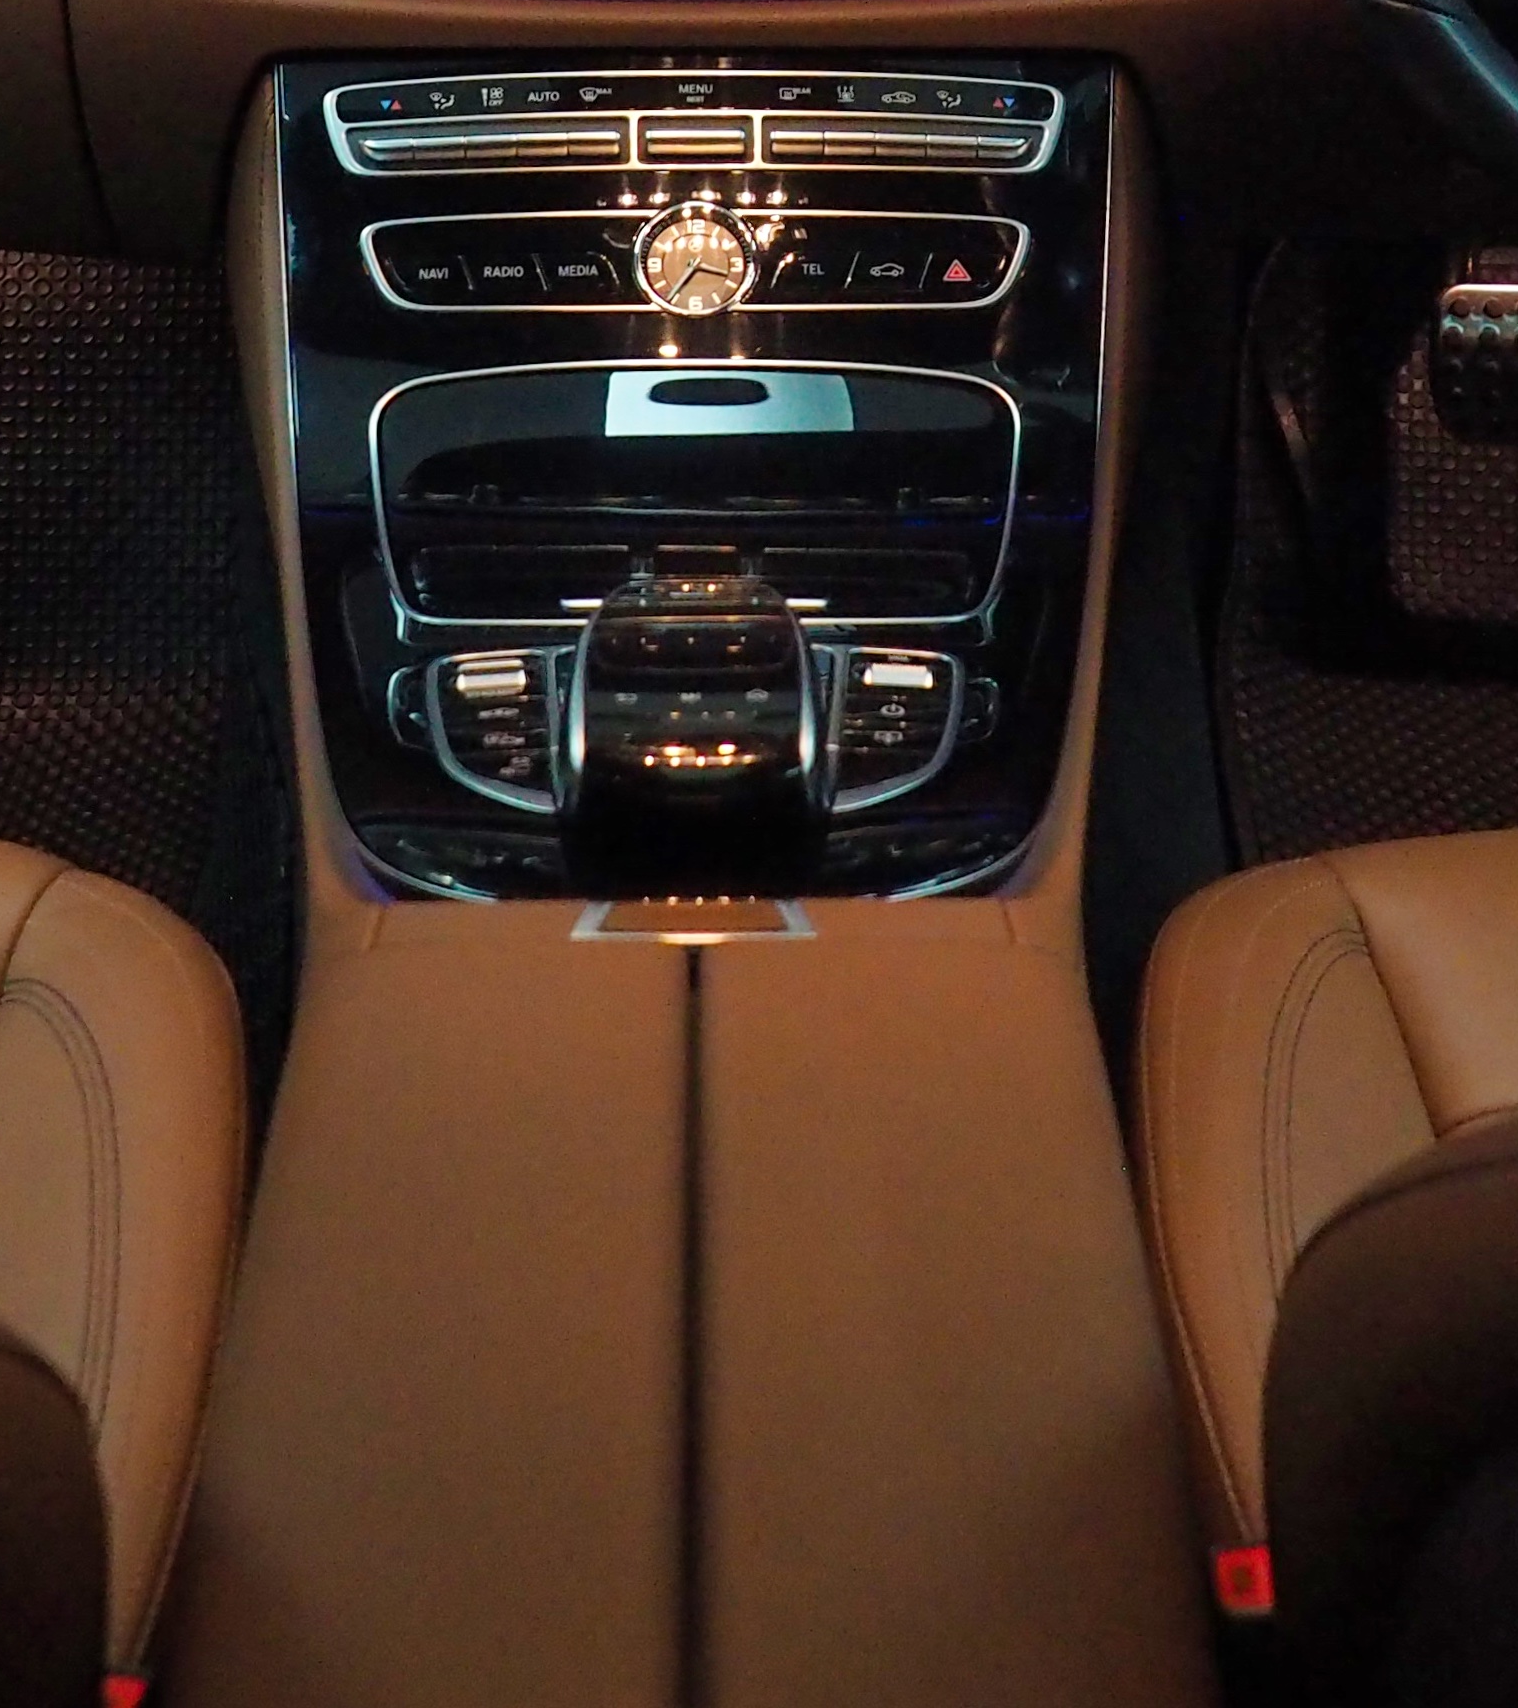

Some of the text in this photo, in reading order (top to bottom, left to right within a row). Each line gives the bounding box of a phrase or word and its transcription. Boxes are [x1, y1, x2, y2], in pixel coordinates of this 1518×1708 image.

[678, 83, 714, 95] MENU
[527, 91, 561, 103] AUTO
[685, 218, 706, 235] 12
[557, 264, 599, 277] MEDIA
[646, 256, 663, 274] 9
[729, 256, 744, 273] 3
[801, 262, 825, 276] TEL
[418, 267, 449, 280] NAVI
[483, 265, 525, 278] RADIO
[687, 295, 704, 312] 6
